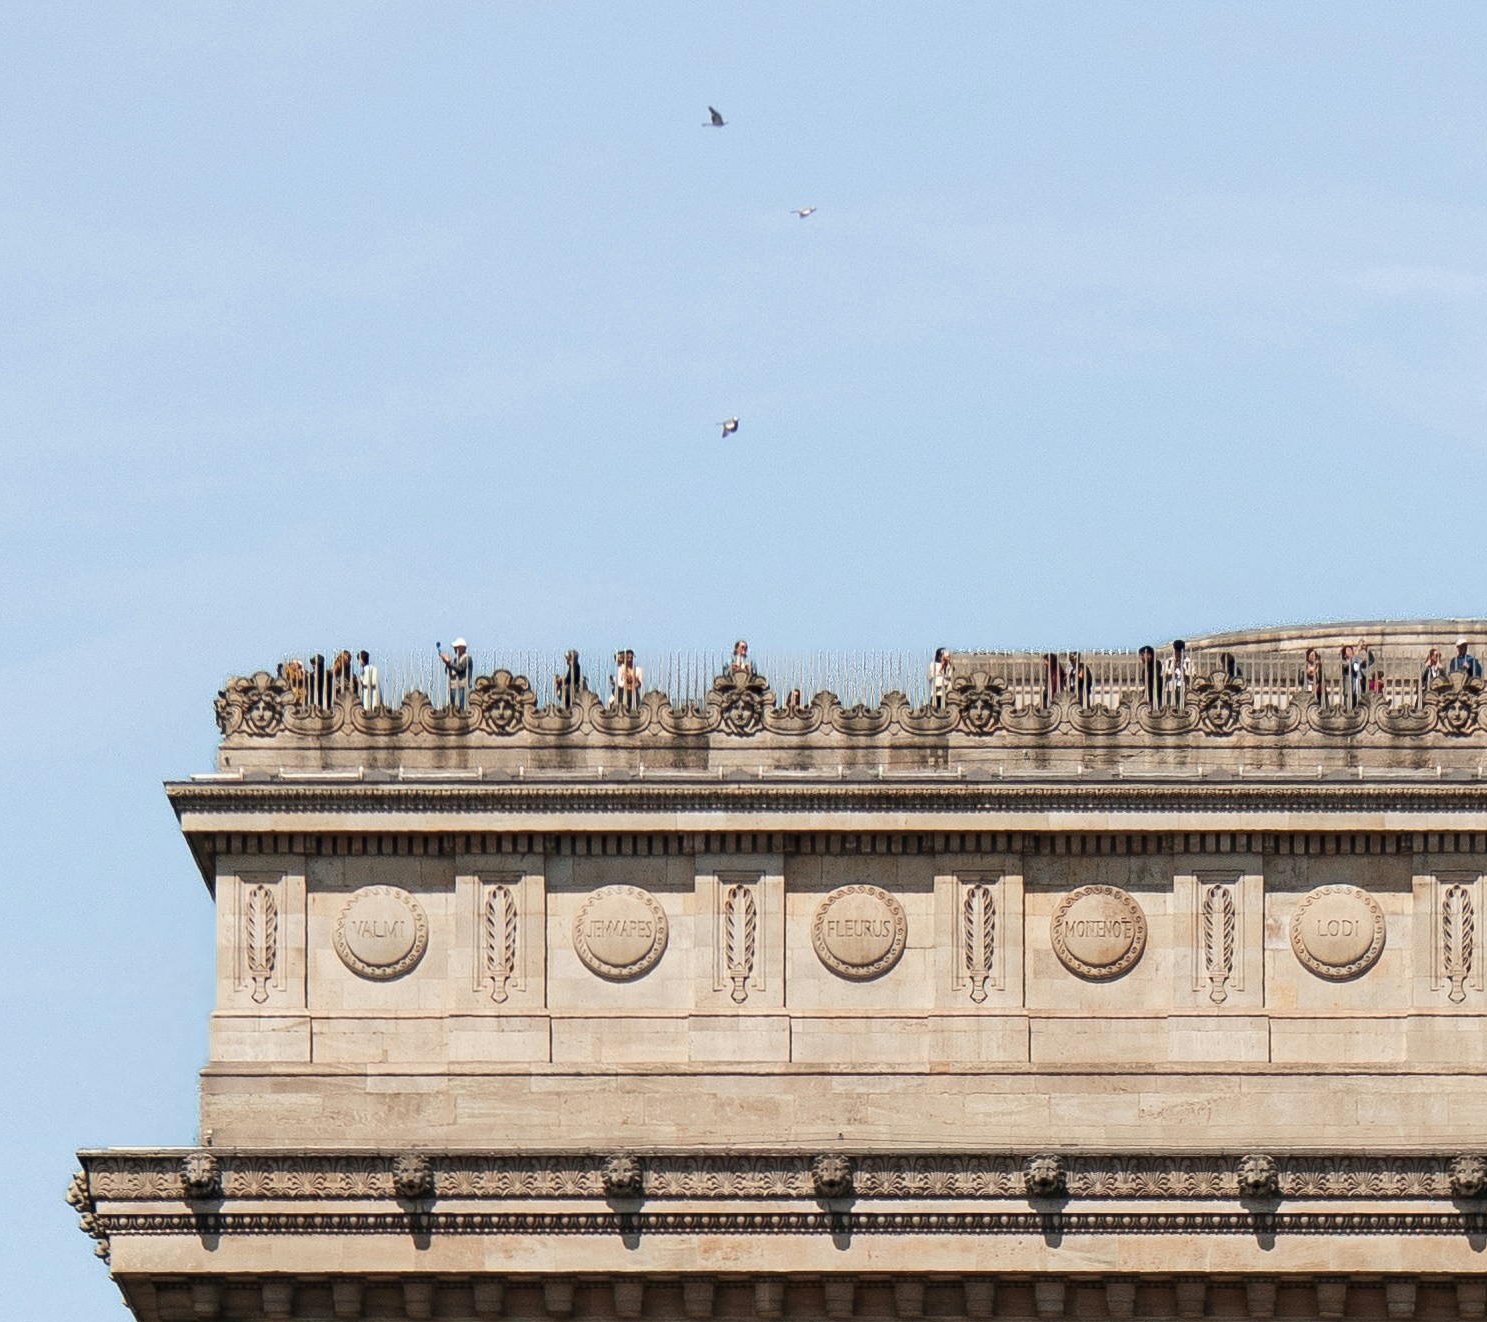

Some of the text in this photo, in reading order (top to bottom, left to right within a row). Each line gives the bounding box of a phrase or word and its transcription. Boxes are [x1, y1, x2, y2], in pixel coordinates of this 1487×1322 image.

[586, 919, 652, 938] JEMMAPES
[826, 919, 891, 939] FLEURUS
[1316, 919, 1360, 938] LODI
